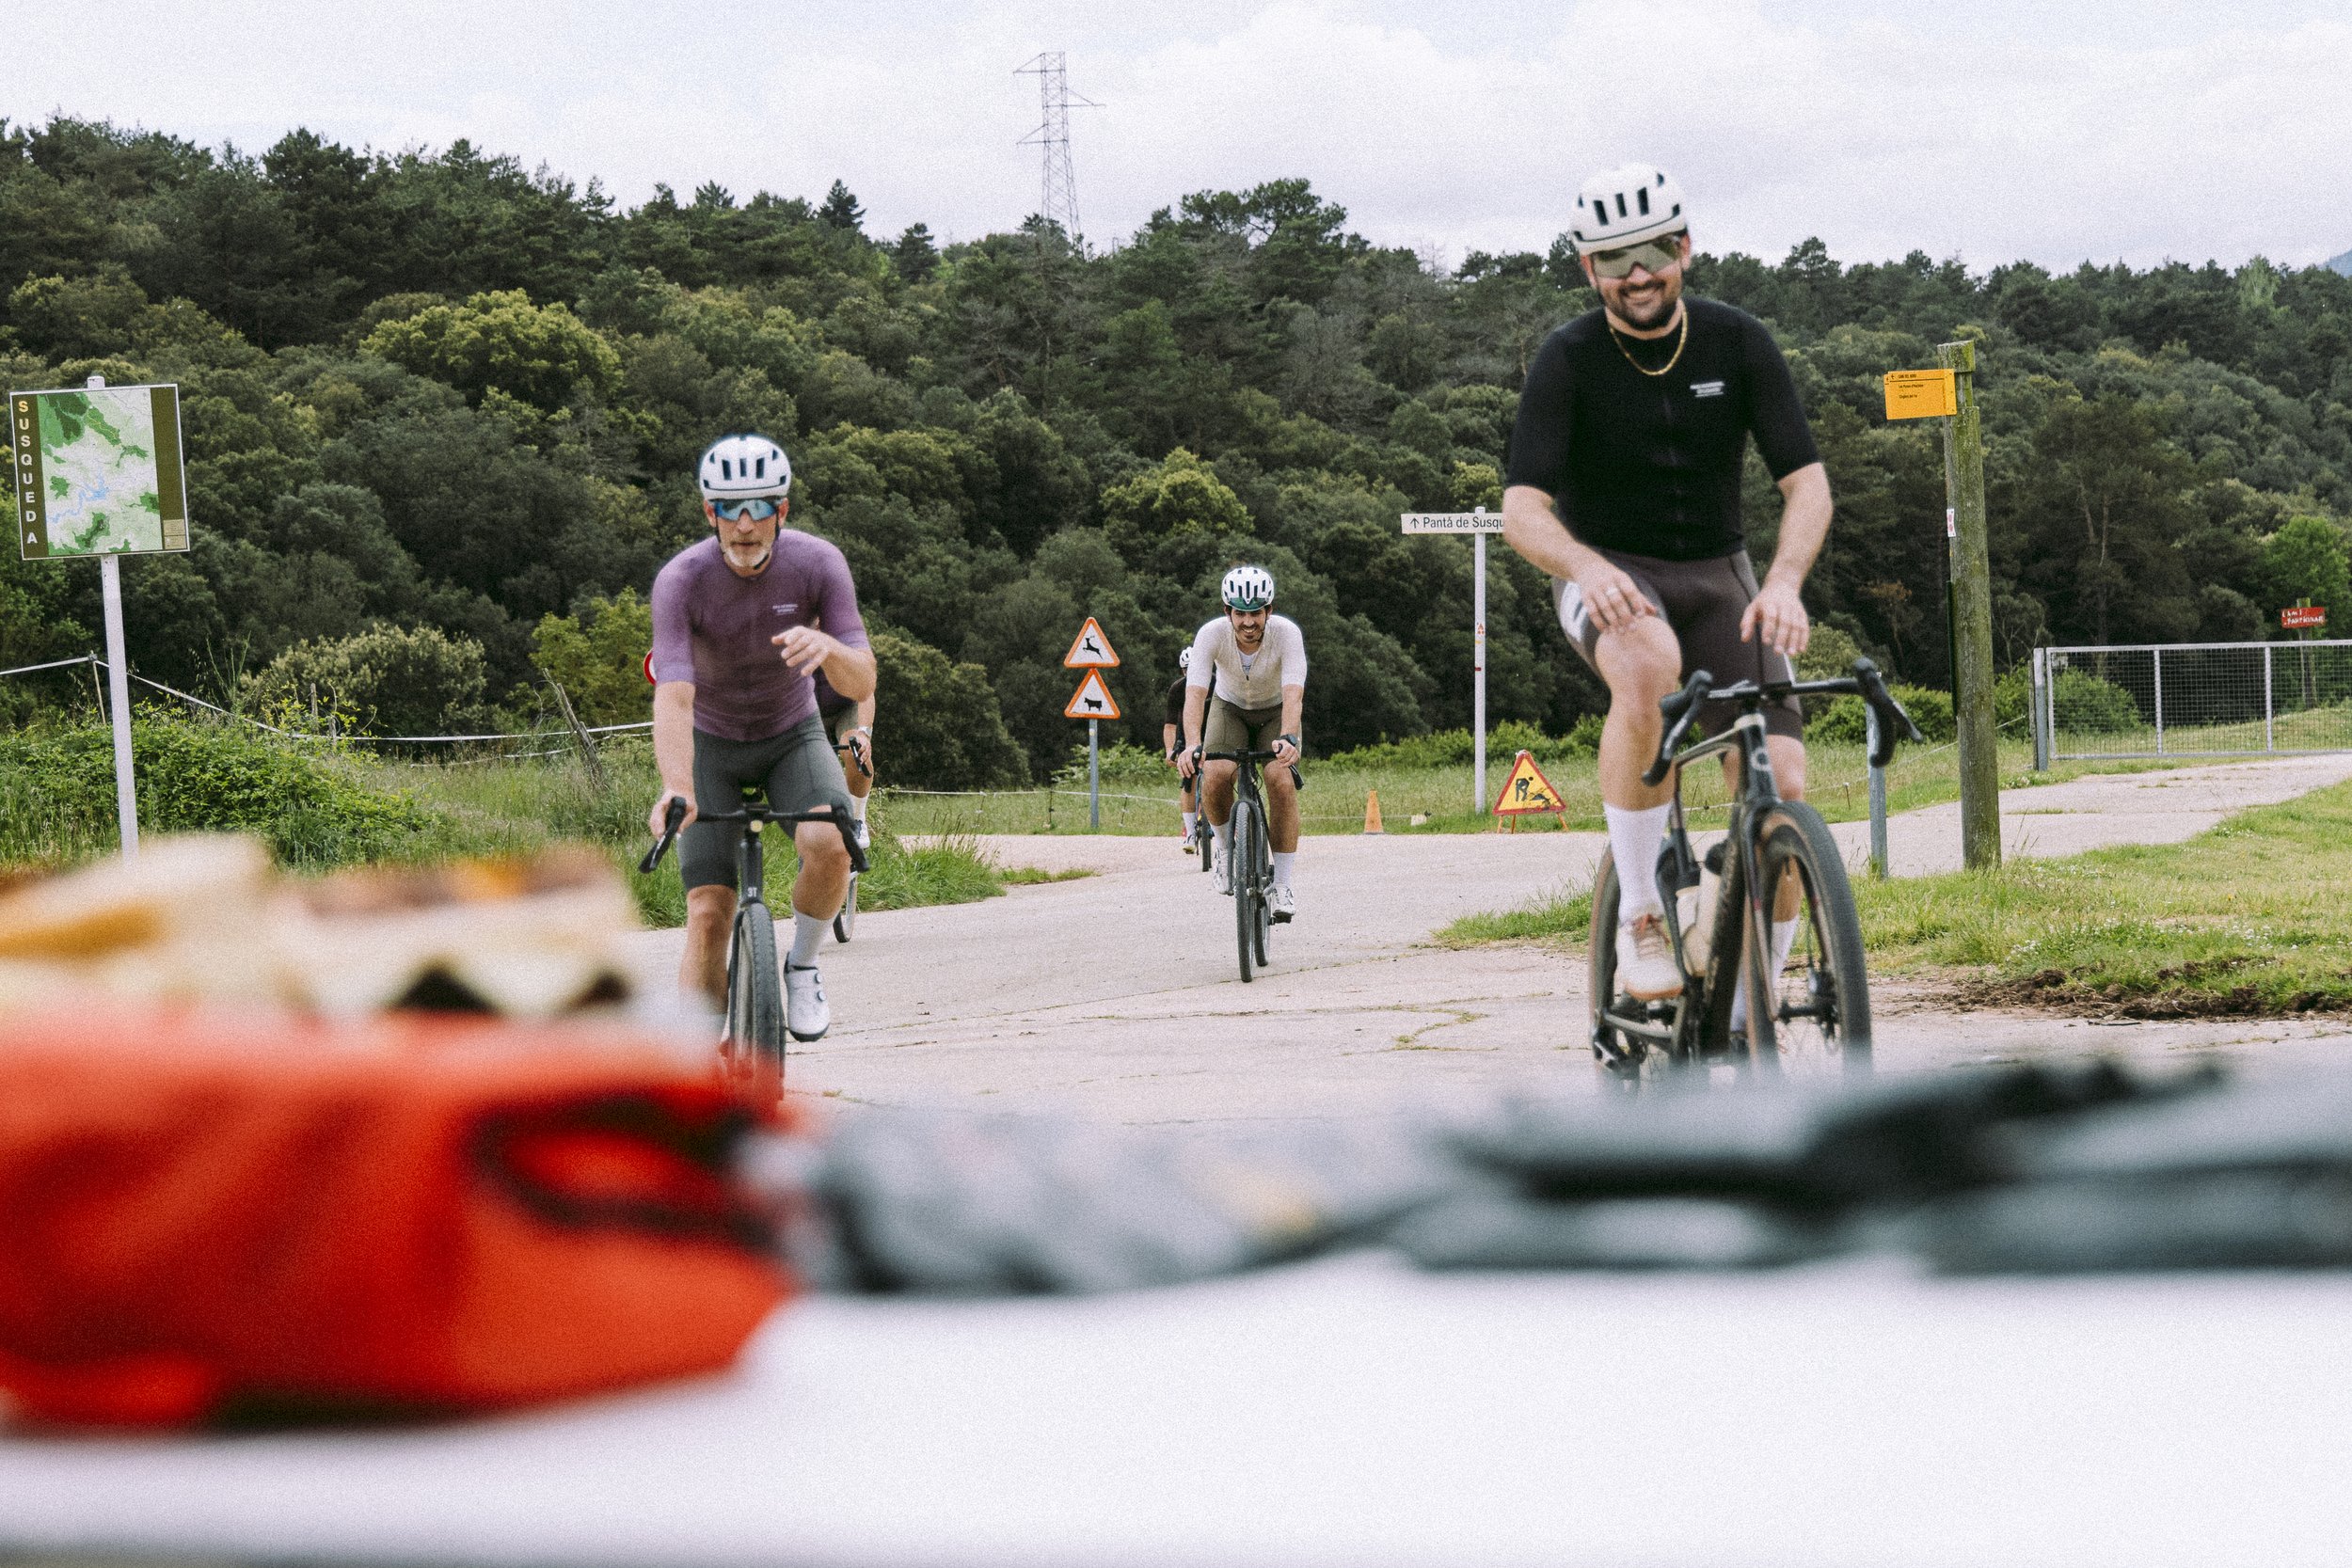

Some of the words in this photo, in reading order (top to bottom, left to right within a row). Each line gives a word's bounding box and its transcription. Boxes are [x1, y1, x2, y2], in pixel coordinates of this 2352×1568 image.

[18, 401, 38, 544] SUSQUEDA
[1455, 516, 1469, 528] de
[747, 887, 757, 897] 3T
